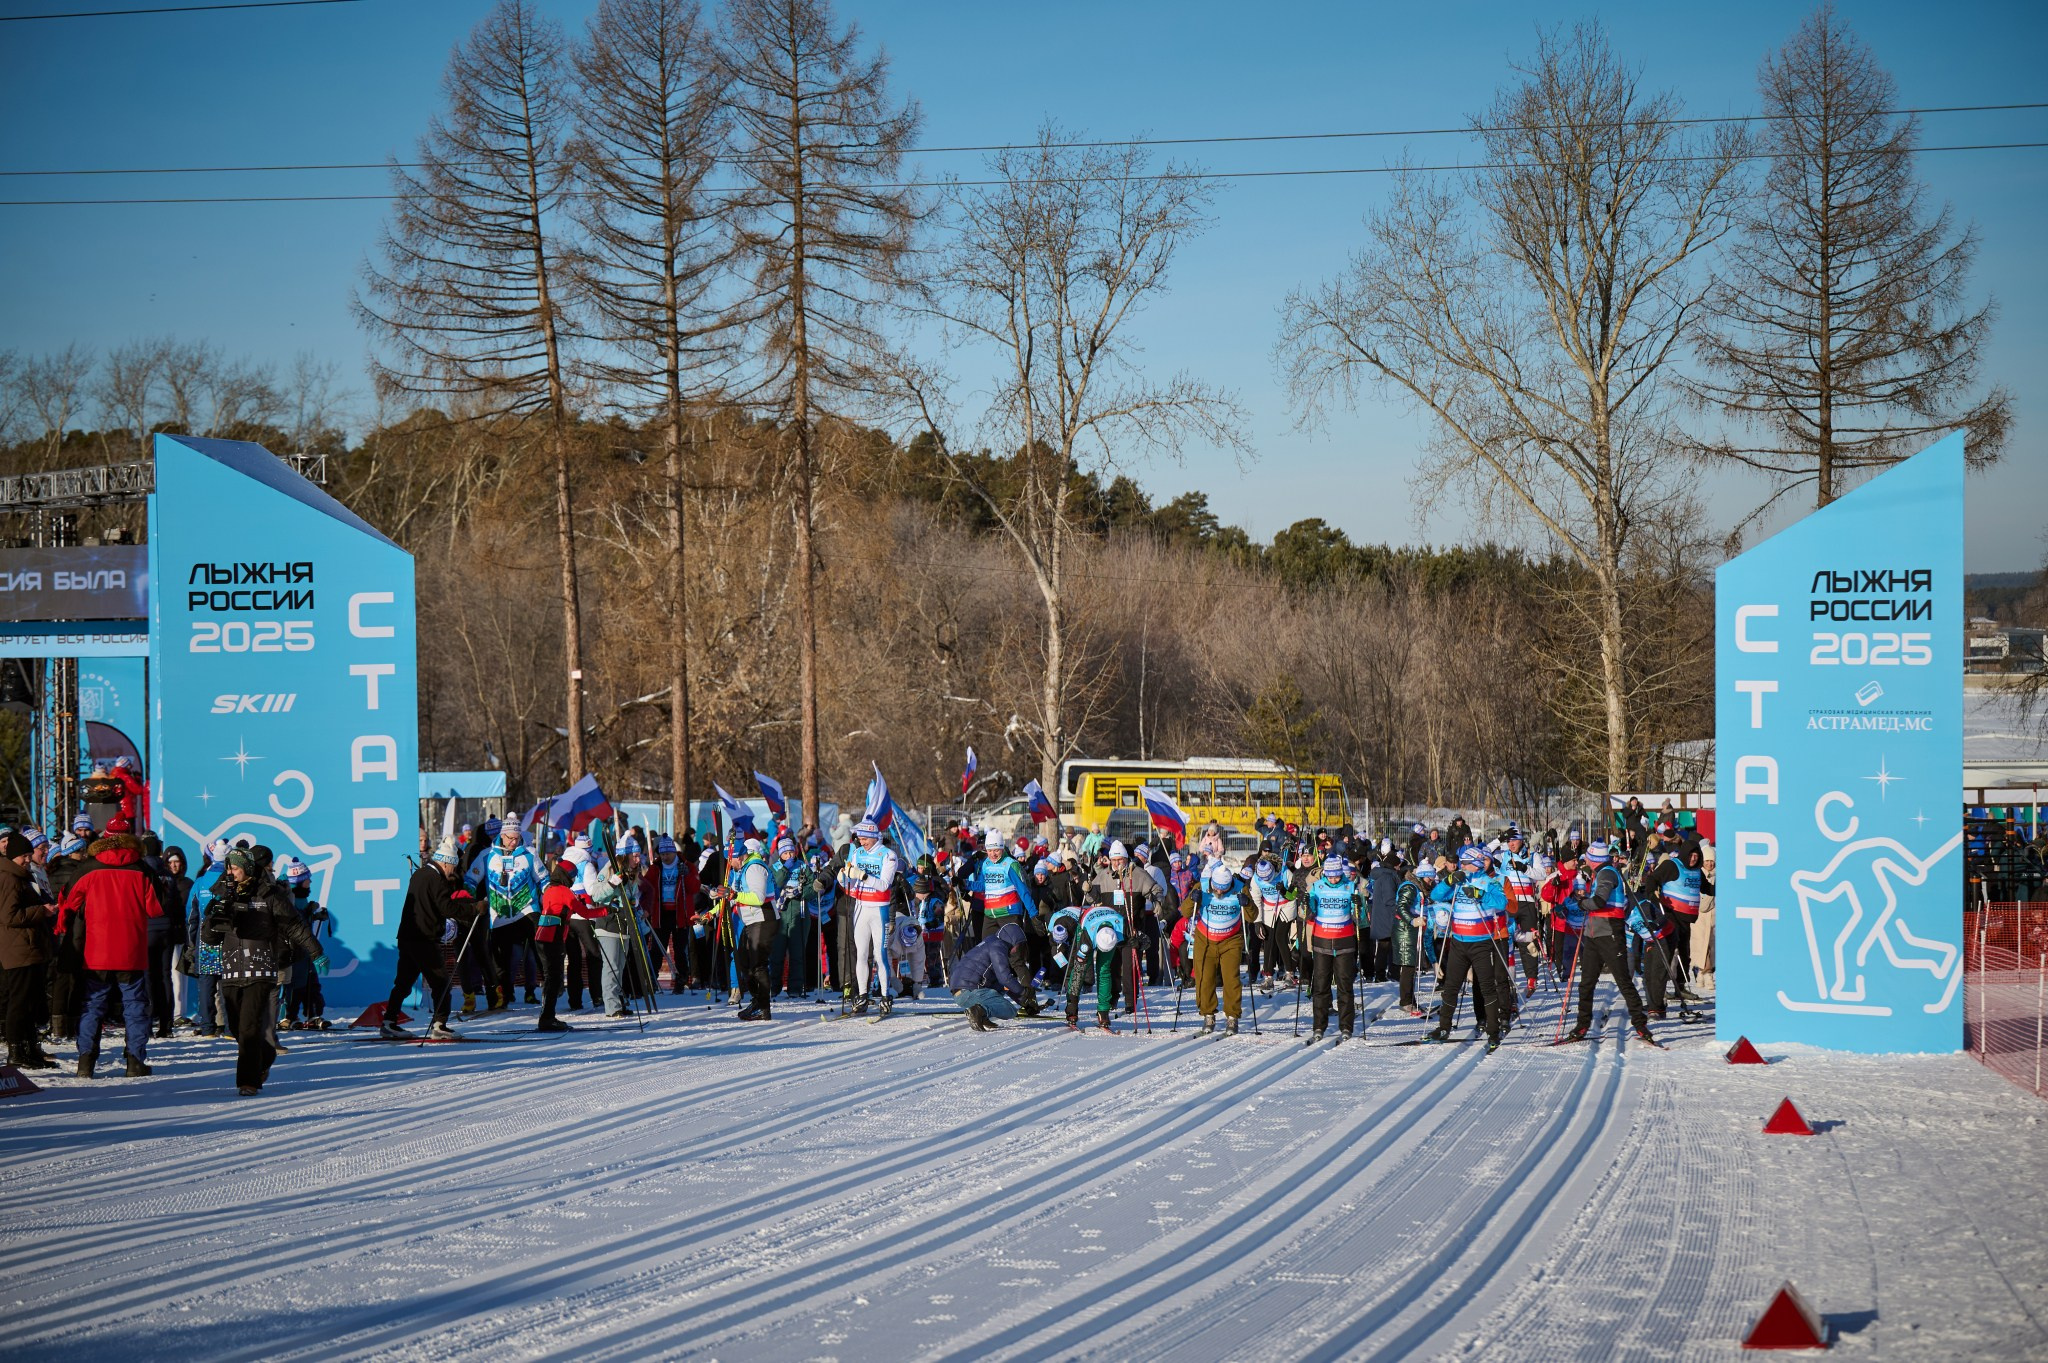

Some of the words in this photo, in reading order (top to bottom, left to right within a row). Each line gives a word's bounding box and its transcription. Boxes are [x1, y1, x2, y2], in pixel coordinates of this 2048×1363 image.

[54, 570, 126, 590] БЫЛА
[189, 562, 314, 584] ЛЫЖНЯ
[1811, 569, 1932, 593] ЛЫЖНЯ
[189, 590, 314, 611] РОССИИ
[1810, 600, 1932, 621] РОССИИ
[190, 621, 315, 652] 2025
[1810, 633, 1933, 666] 2025
[1806, 716, 1934, 733] АСТРАМЕД-МС
[348, 592, 401, 925] СТАРТ
[1735, 604, 1780, 956] СТАРТ
